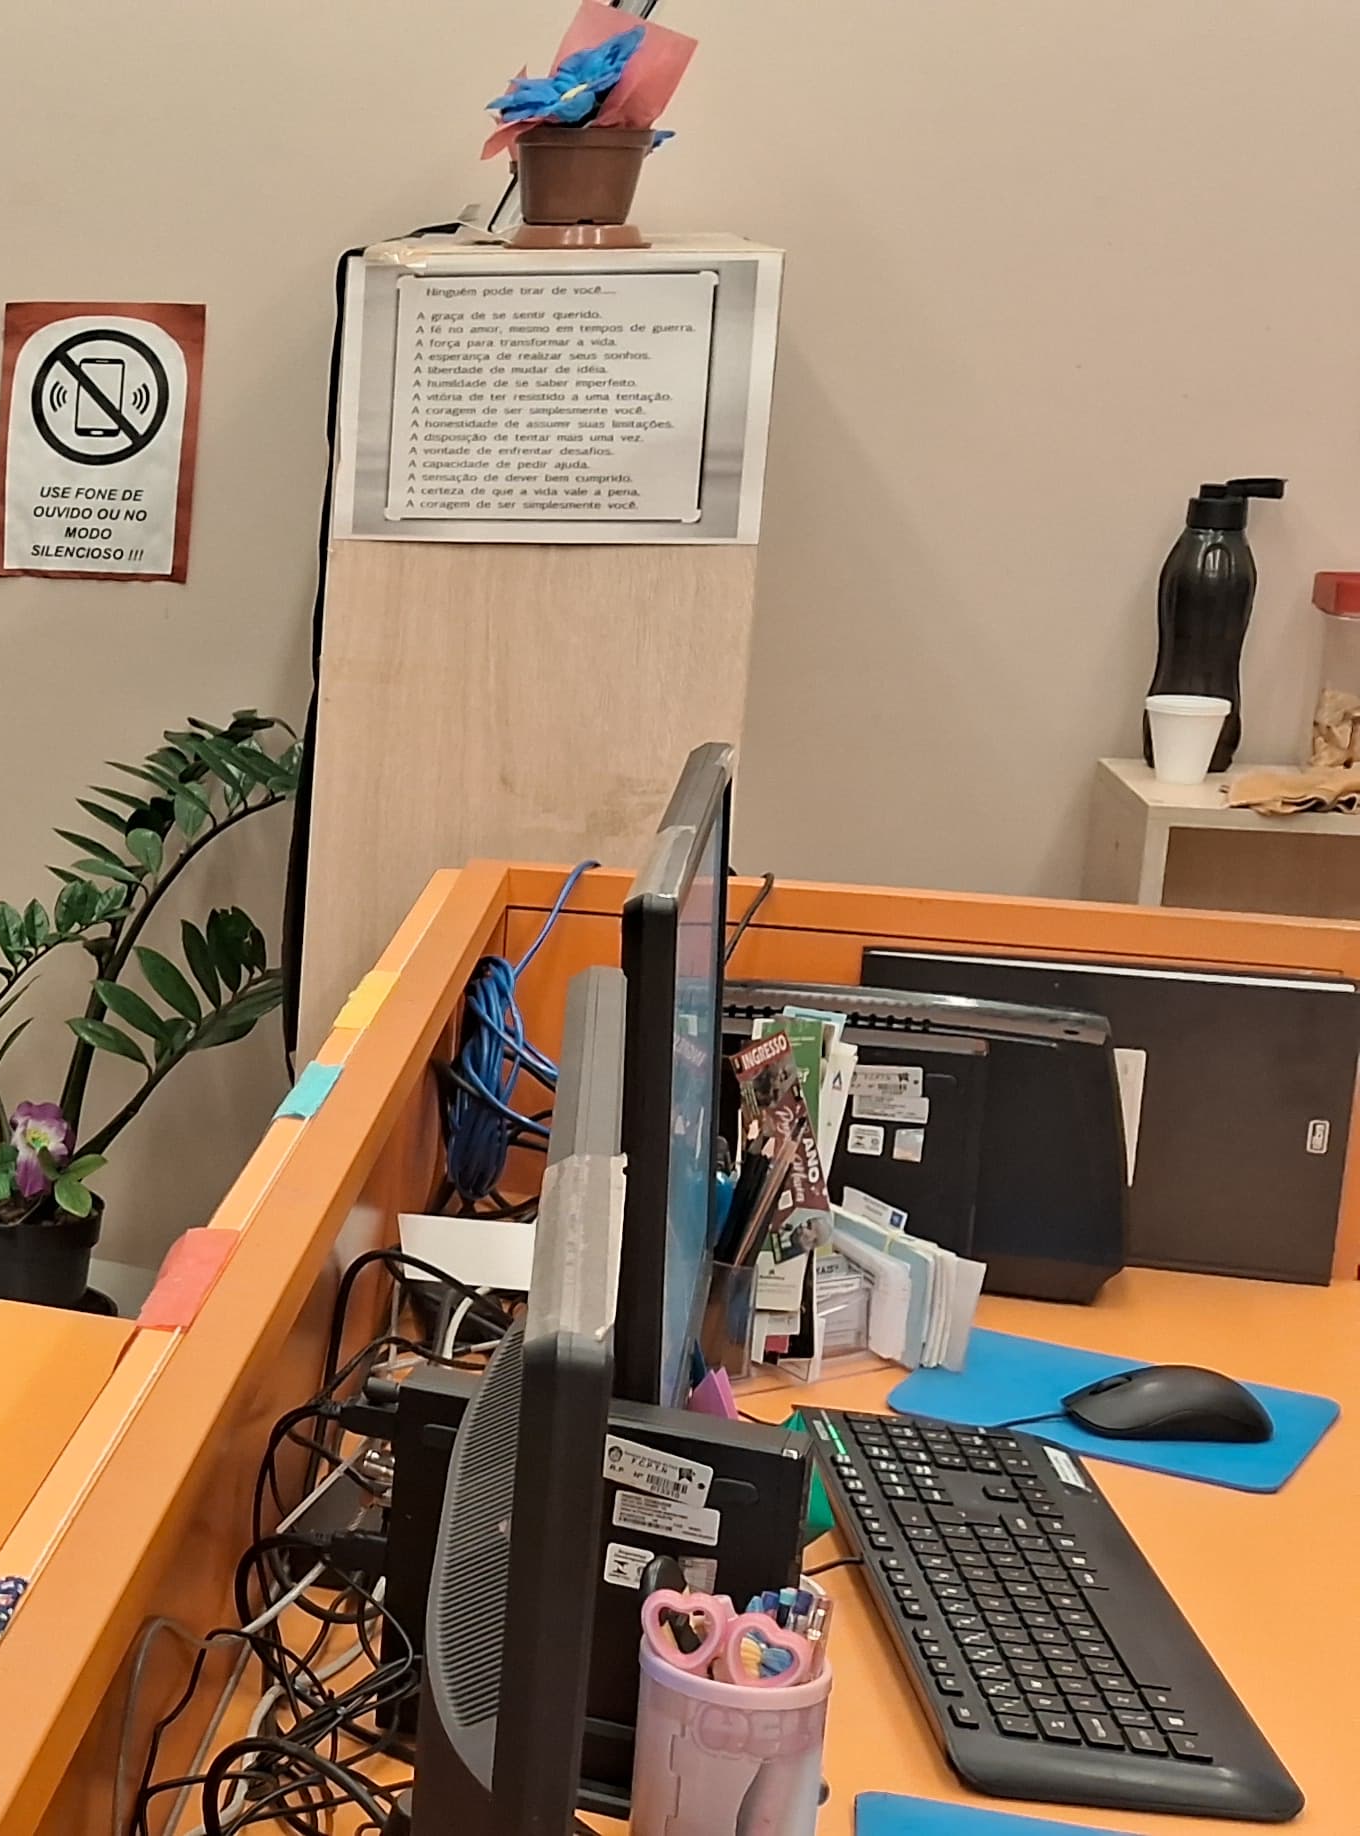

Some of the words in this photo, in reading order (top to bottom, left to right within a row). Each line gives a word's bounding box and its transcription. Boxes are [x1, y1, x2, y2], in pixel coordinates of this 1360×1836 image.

[426, 287, 477, 298] Ninguém
[482, 287, 514, 298] pode
[520, 286, 545, 295] tirar
[551, 286, 567, 295] de
[416, 311, 425, 320] A
[431, 314, 464, 323] graça
[471, 311, 486, 320] de
[512, 311, 546, 320] sentir
[552, 311, 602, 322] querido.
[415, 325, 425, 334] A
[430, 325, 442, 334] fé
[470, 327, 503, 336] amor,
[580, 324, 623, 335] tempos
[630, 324, 646, 333] de
[652, 326, 696, 335] guerra.
[415, 339, 424, 347] A
[430, 338, 461, 350] força
[467, 340, 494, 349] para
[500, 338, 570, 347] transformar
[414, 352, 423, 361] A
[428, 354, 490, 363] esperança
[496, 352, 512, 360] de
[518, 351, 563, 360] realizar
[604, 351, 652, 360] sonhos.
[414, 366, 422, 374] A
[428, 365, 484, 374] liberdade
[489, 365, 505, 374] de
[511, 365, 548, 374] mudar
[555, 365, 570, 374] de
[413, 379, 422, 387] A
[427, 379, 487, 387] humildade
[493, 378, 509, 387] de
[535, 378, 569, 387] saber
[412, 392, 421, 401] A
[426, 392, 463, 401] vitória
[469, 392, 484, 401] de
[490, 392, 506, 401] ter
[513, 392, 565, 401] resistido
[616, 392, 673, 403] tentação.
[411, 406, 420, 415] A
[425, 408, 476, 417] coragem
[482, 406, 498, 415] de
[529, 406, 608, 417] simplesmente
[410, 419, 419, 428] A
[424, 419, 498, 428] honestidade
[504, 419, 520, 428] de
[526, 420, 571, 428] assumir
[409, 433, 418, 441] A
[424, 433, 487, 444] disposição
[493, 433, 509, 442] de
[515, 433, 551, 442] tentar
[556, 433, 584, 442] mais
[408, 446, 418, 455] A
[423, 446, 471, 455] vontade
[476, 446, 492, 455] de
[498, 447, 553, 455] enfrentar
[408, 460, 417, 468] A
[422, 460, 490, 471] capacidade
[496, 460, 511, 469] de
[517, 460, 548, 471] pedir
[407, 472, 416, 481] A
[421, 472, 477, 484] sensação
[483, 473, 499, 482] de
[505, 473, 538, 482] dever
[544, 473, 569, 482] bem
[40, 486, 71, 498] USE
[75, 488, 117, 500] FONE
[121, 489, 144, 501] DE
[406, 486, 415, 495] A
[420, 486, 464, 495] certeza
[471, 486, 485, 495] de
[492, 489, 514, 498] que
[533, 487, 558, 496] vida
[564, 487, 588, 496] vale
[406, 499, 414, 508] A
[420, 502, 470, 511] coragem
[476, 500, 491, 509] de
[522, 500, 601, 512] simplesmente
[33, 506, 92, 520] OUVIDO
[97, 508, 120, 520] OU
[124, 509, 147, 522] NO
[64, 527, 112, 540] MODO
[31, 545, 124, 560] SILENCIOSO
[128, 549, 144, 561] !!!
[741, 1034, 787, 1071] INGRESSO
